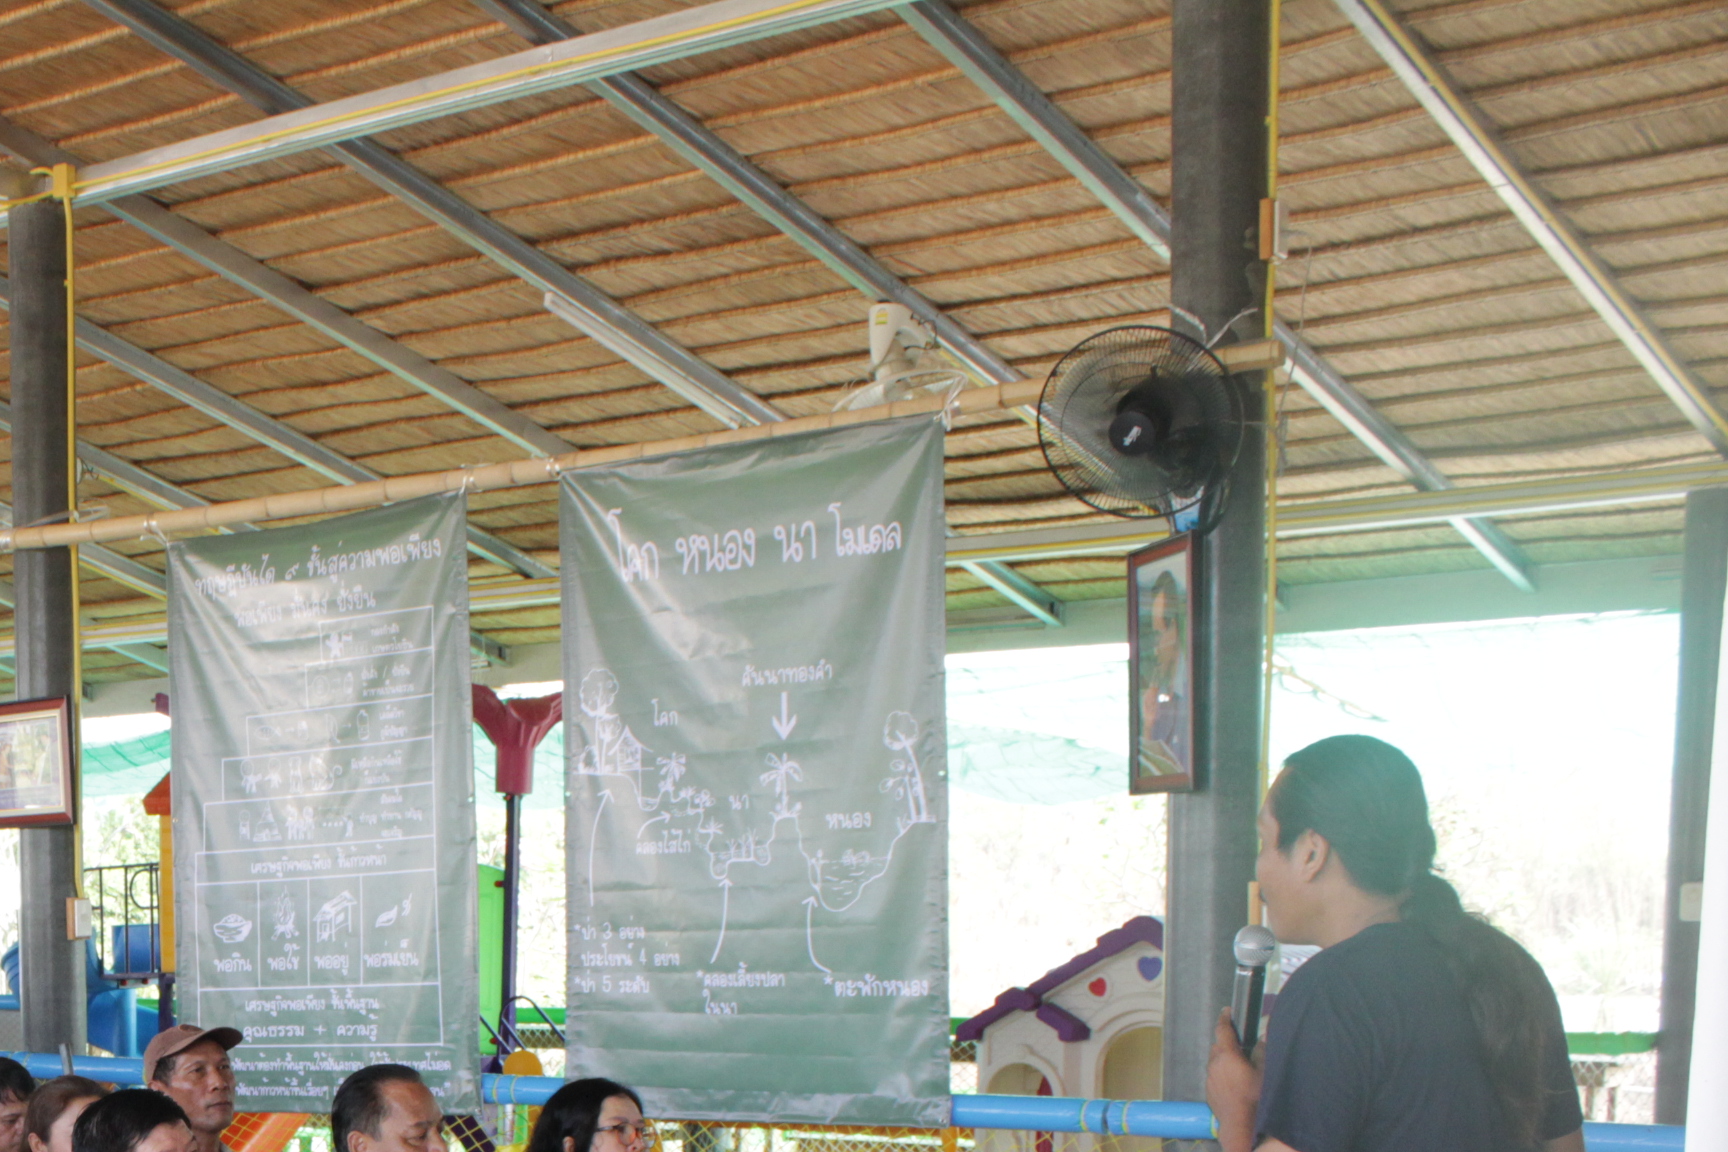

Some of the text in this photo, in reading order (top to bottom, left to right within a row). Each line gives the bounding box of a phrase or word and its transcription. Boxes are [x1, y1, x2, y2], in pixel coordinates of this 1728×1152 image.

[606, 502, 902, 582] โคก หนอง นา โมเดล
[194, 553, 276, 598] ทฤษฎีบันได
[742, 659, 833, 687] คันนาทองคำ
[651, 698, 678, 726] โคก
[729, 795, 749, 811] นา
[826, 812, 872, 830] หนอง
[250, 843, 387, 878] เศรษฐกิจพอเพียง ขั้นก้าวหน้า
[581, 915, 645, 940] ป่า 3 อย่าง
[213, 952, 252, 973] พอกิน
[267, 942, 301, 971] พอใช้
[314, 940, 349, 976] พออยู่
[363, 938, 420, 969] พอร่มเย็น
[581, 941, 680, 967] ประโยชน์ 4 อย่าง
[581, 970, 650, 994] ป่า 5 ระดับ
[703, 962, 786, 988] คลองเลี้ยงปลา
[834, 974, 929, 998] ตะพักหนอง
[244, 994, 325, 1017] เศรษฐกิจพอเพียง
[702, 989, 738, 1014] ในนา
[243, 1025, 305, 1044] คุณธรรม
[336, 1013, 379, 1042] ความรู้
